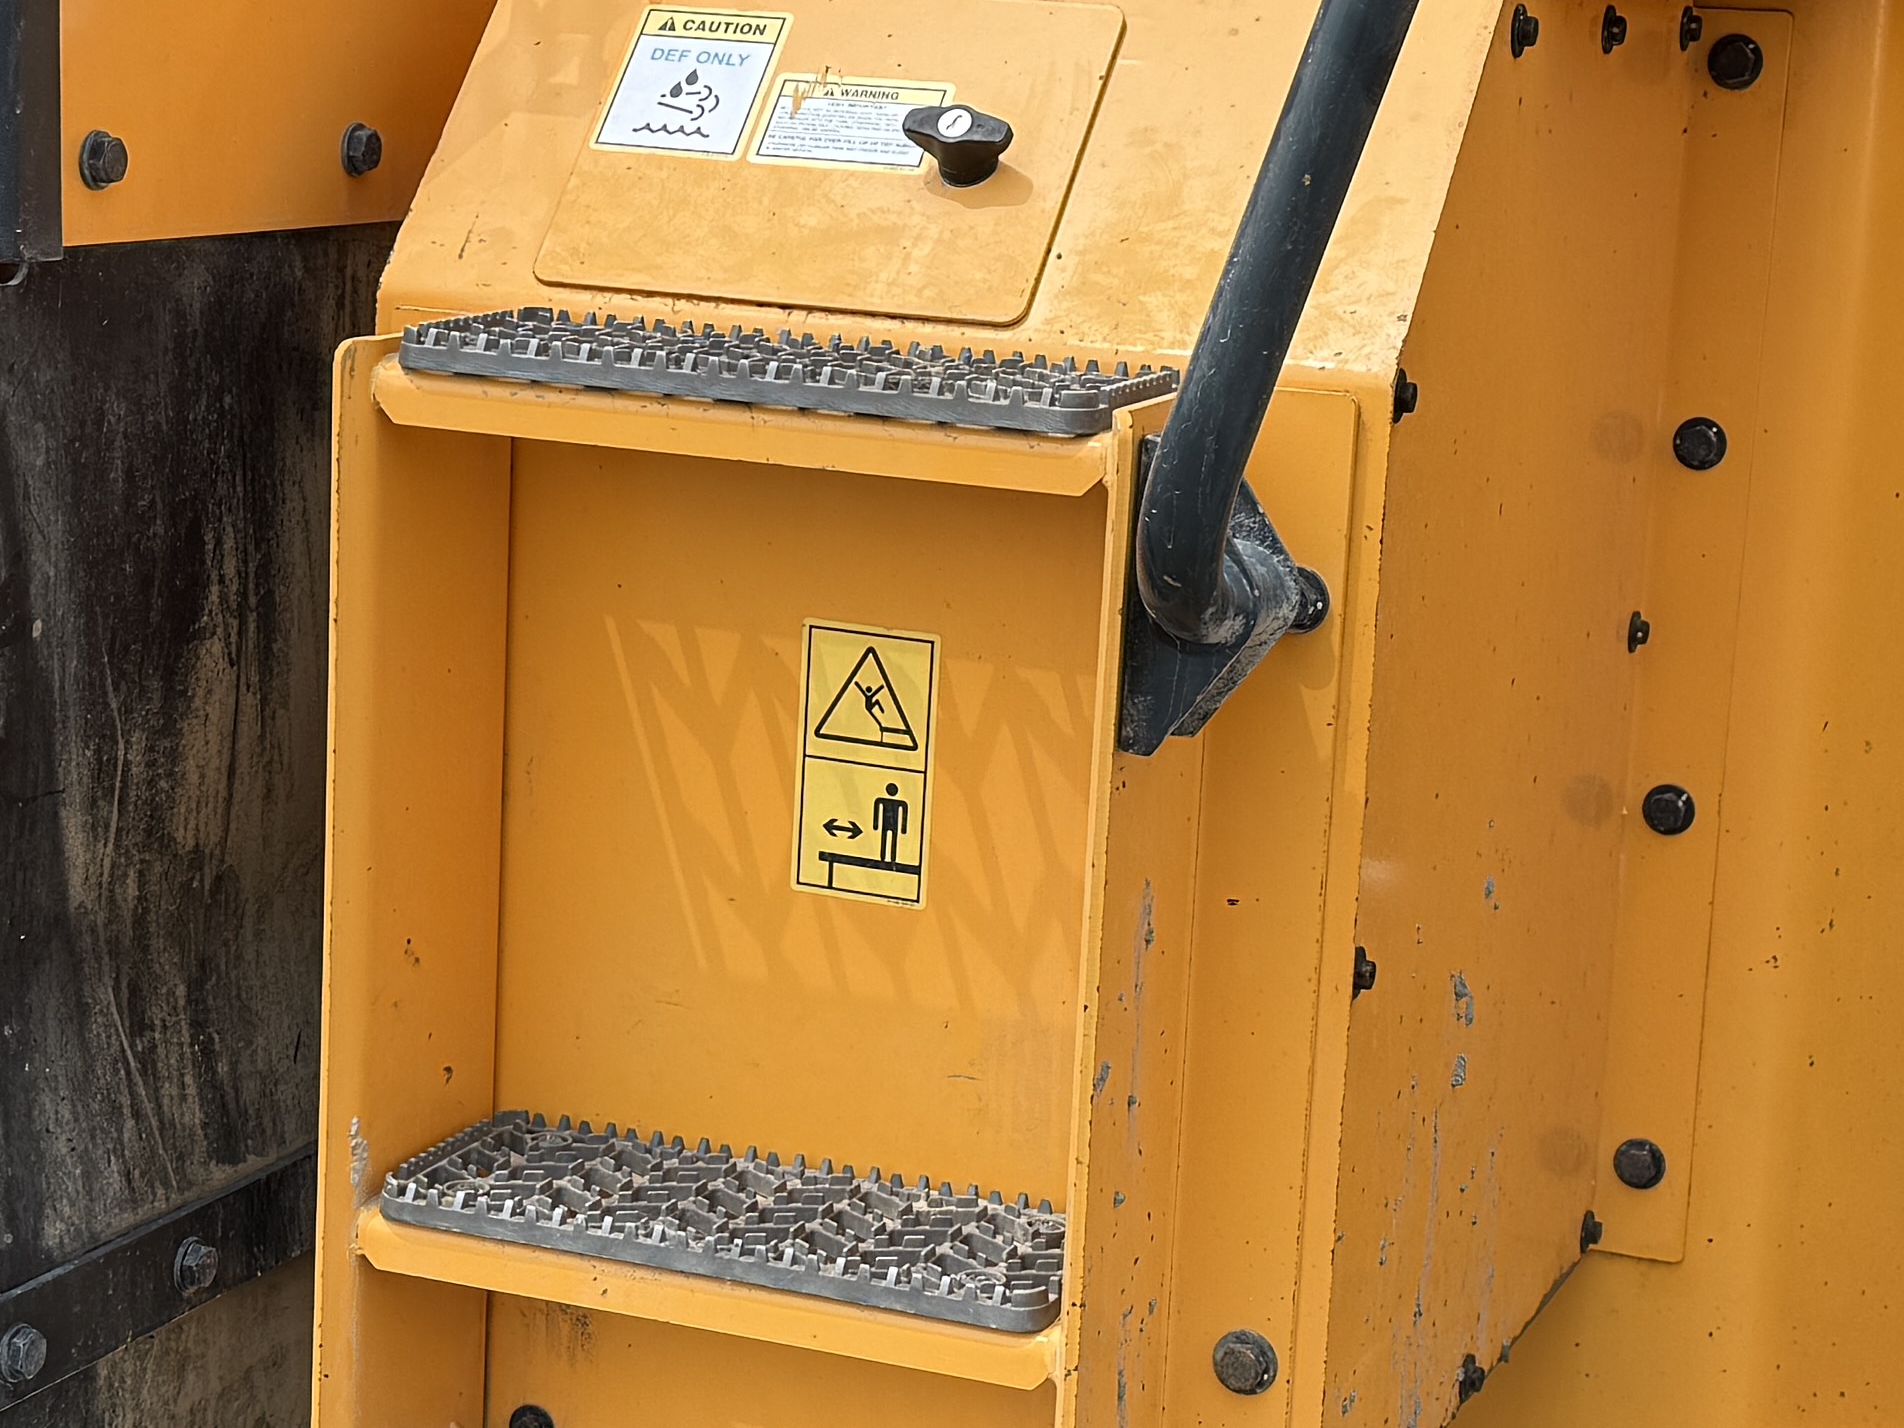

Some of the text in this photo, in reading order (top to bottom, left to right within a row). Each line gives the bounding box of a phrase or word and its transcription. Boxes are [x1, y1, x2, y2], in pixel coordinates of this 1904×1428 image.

[682, 19, 767, 36] CAUTION
[650, 47, 751, 66] DEF ONLY
[840, 87, 900, 100] WARNING
